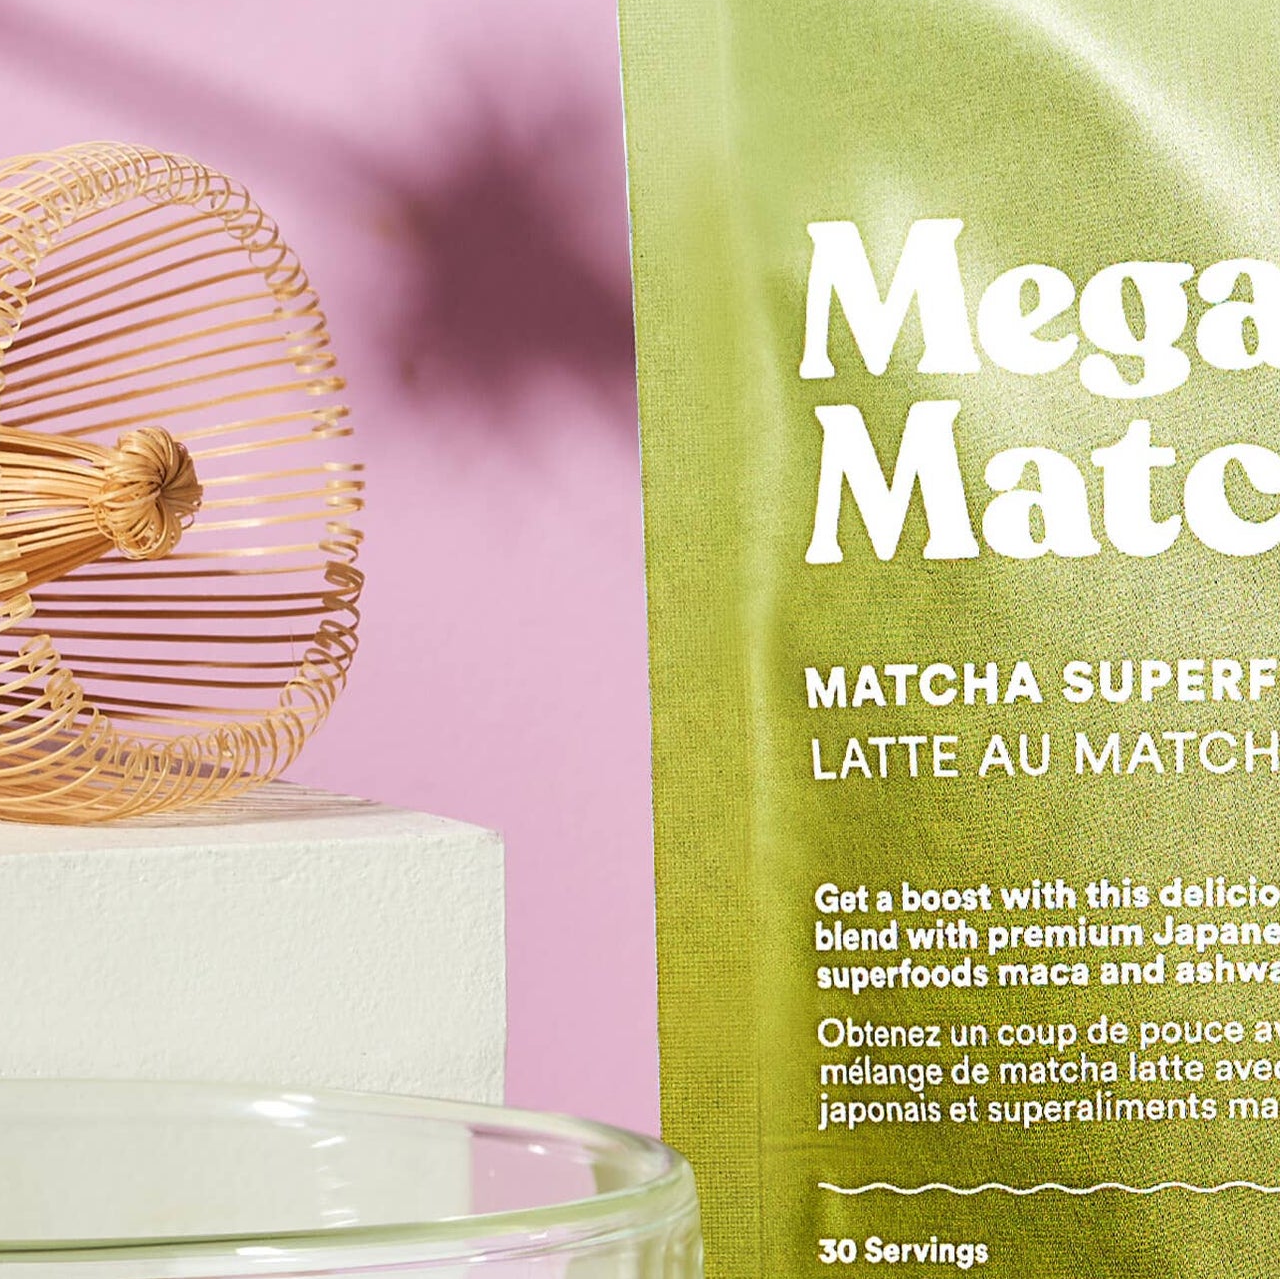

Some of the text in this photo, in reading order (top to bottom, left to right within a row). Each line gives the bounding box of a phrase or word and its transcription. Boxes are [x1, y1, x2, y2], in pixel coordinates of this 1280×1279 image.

[805, 662, 1043, 708] MATCHA
[811, 735, 958, 780] LATTE
[979, 734, 1050, 776] AU
[815, 883, 869, 912] Get
[876, 888, 893, 911] a
[902, 880, 992, 911] boost
[1001, 879, 1076, 909] with
[1085, 877, 1149, 908] this
[815, 918, 897, 949] blend
[907, 917, 978, 948] with
[988, 917, 1143, 953] premium
[817, 956, 989, 992] superfoods
[998, 962, 1089, 984] maca
[1101, 953, 1165, 984] and
[817, 1015, 941, 1046] Obtenez
[951, 1024, 987, 1045] un
[997, 1022, 1075, 1051] coup
[1087, 1013, 1128, 1043] de
[1140, 1020, 1245, 1049] pouce
[820, 1053, 942, 1090] mélange
[952, 1053, 990, 1083] de
[1000, 1052, 1119, 1082] matcha
[1130, 1050, 1205, 1082] latte
[819, 1090, 941, 1127] japonais
[949, 1093, 980, 1121] et
[988, 1089, 1217, 1126] superaliments
[818, 1236, 989, 1268] 30 Servings
